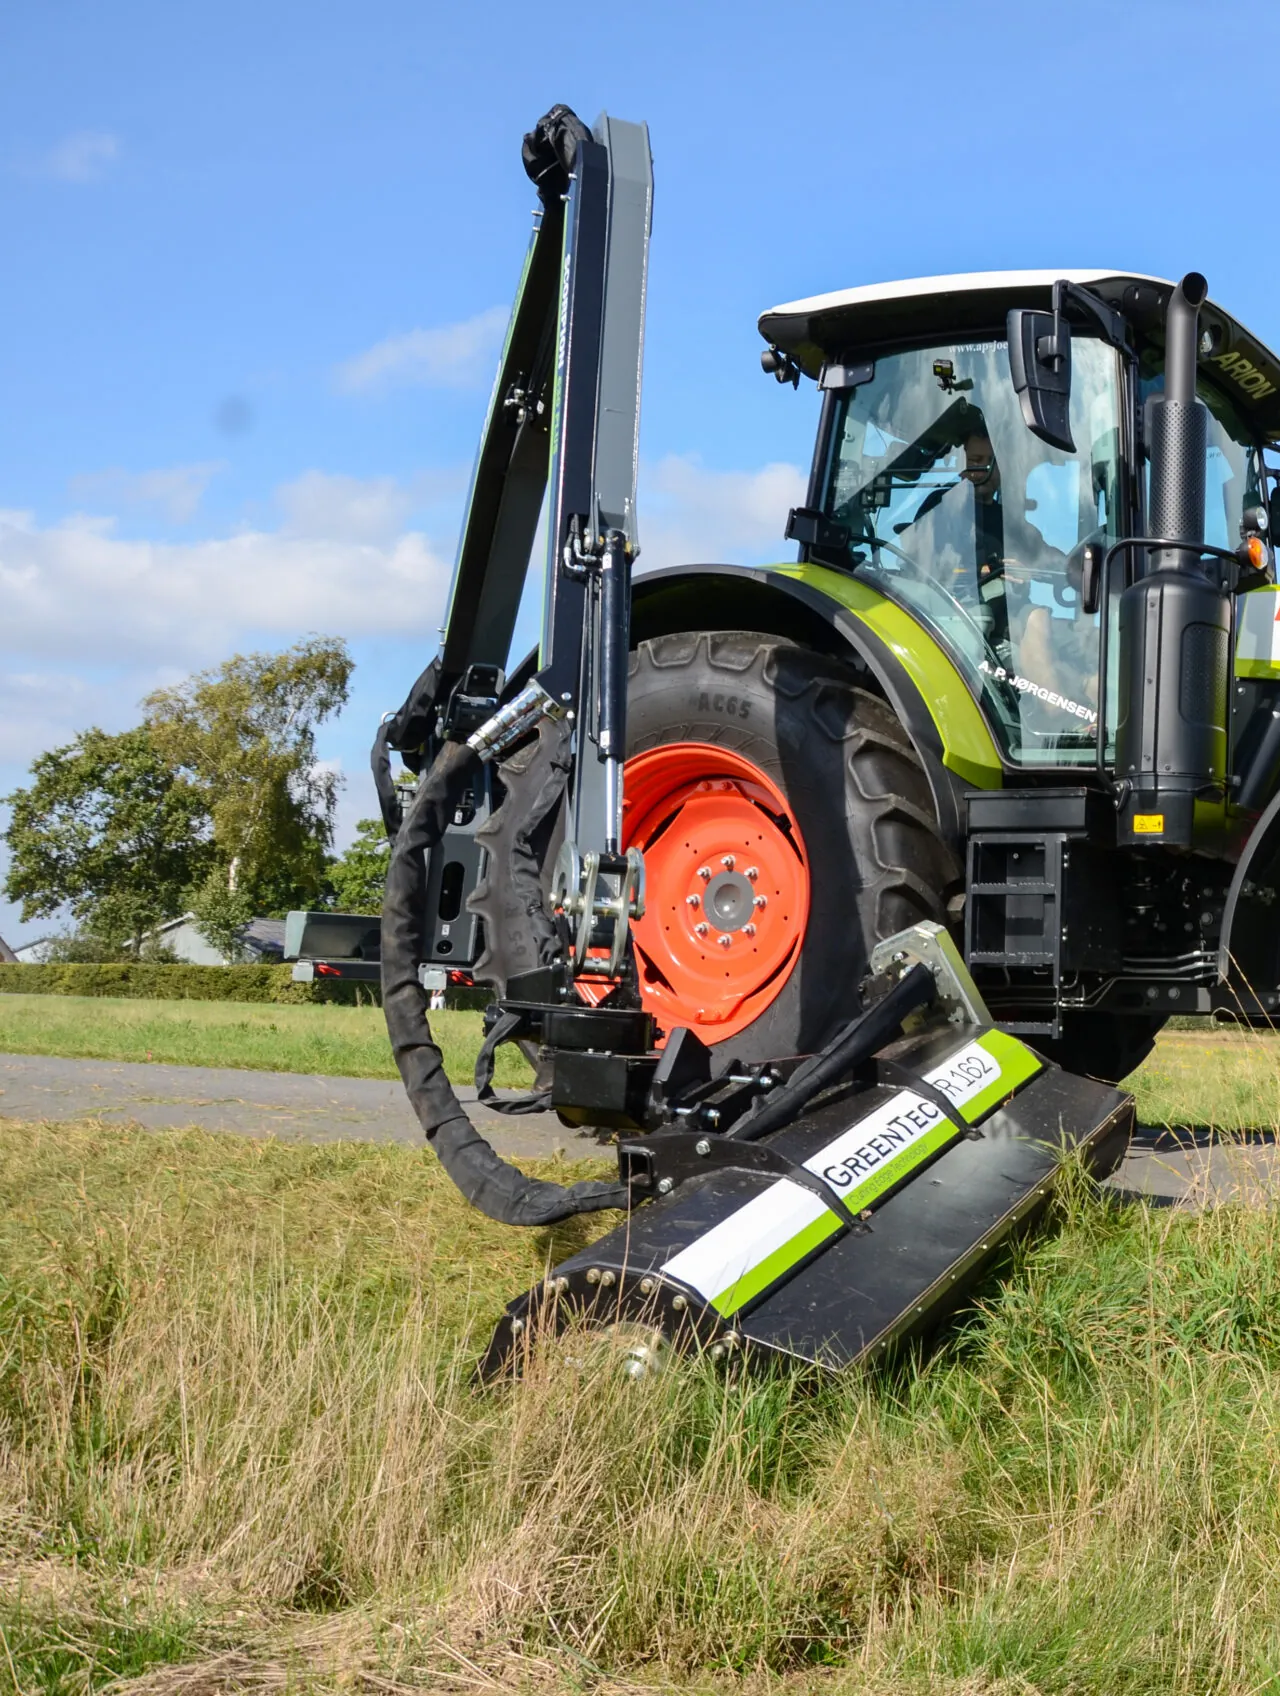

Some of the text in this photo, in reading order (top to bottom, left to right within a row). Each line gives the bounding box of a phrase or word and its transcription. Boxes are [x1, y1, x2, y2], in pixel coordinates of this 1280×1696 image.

[1210, 351, 1277, 400] ARION
[698, 691, 752, 719] AC65
[978, 660, 1098, 723] A. P. JØRGENSEN
[949, 1055, 993, 1088] 162
